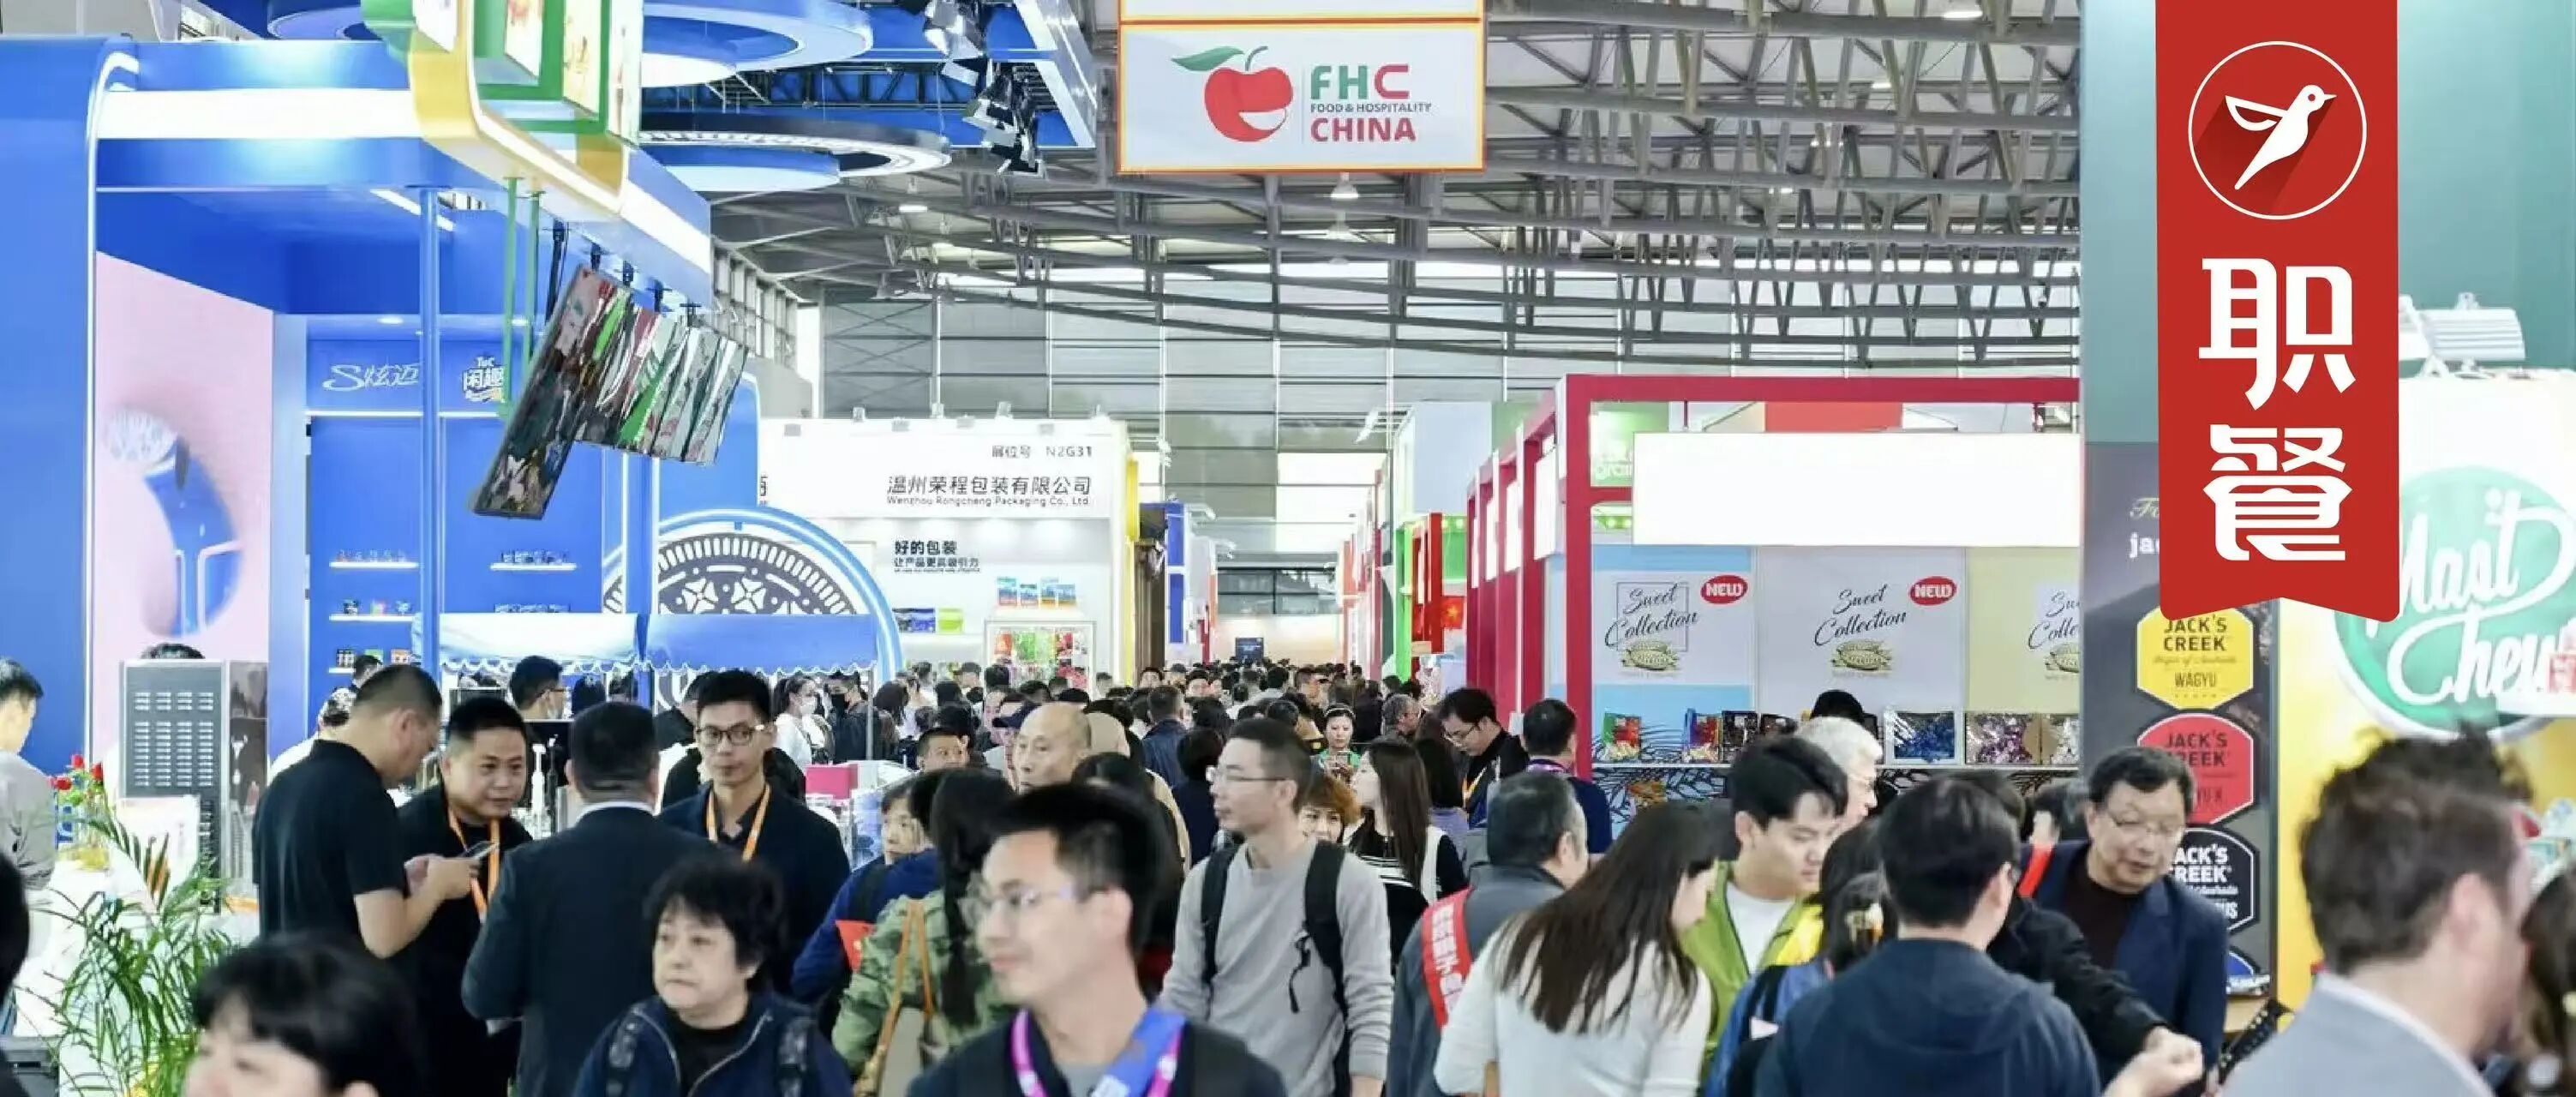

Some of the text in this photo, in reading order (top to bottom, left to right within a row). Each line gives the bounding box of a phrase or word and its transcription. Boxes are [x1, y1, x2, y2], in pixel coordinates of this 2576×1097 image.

[1310, 64, 1410, 100] FHC
[1310, 103, 1432, 113] FOOD & HOSPITALITY
[1310, 117, 1417, 142] CHINA
[1045, 446, 1093, 458] N2G31
[886, 475, 1092, 495] 温州荣程包装有限公司
[886, 496, 932, 506] Wenzhou
[936, 496, 991, 507] Rongcheng
[995, 496, 1045, 507] Packaging
[895, 540, 958, 555] 好的包装
[1623, 583, 1680, 615] Sweet
[1705, 583, 1743, 598] NEW
[1832, 584, 1887, 614] Sweet
[1914, 584, 1951, 597] NEW
[1604, 610, 1699, 647] Collection
[1813, 611, 1907, 646] Collection
[2164, 614, 2227, 633] JACK'S
[2164, 637, 2226, 651] CREEK
[2175, 671, 2217, 688] WAGYU
[2167, 730, 2228, 749] JACK'S
[2173, 843, 2229, 865] ACK'S
[2171, 865, 2226, 883] REEK
